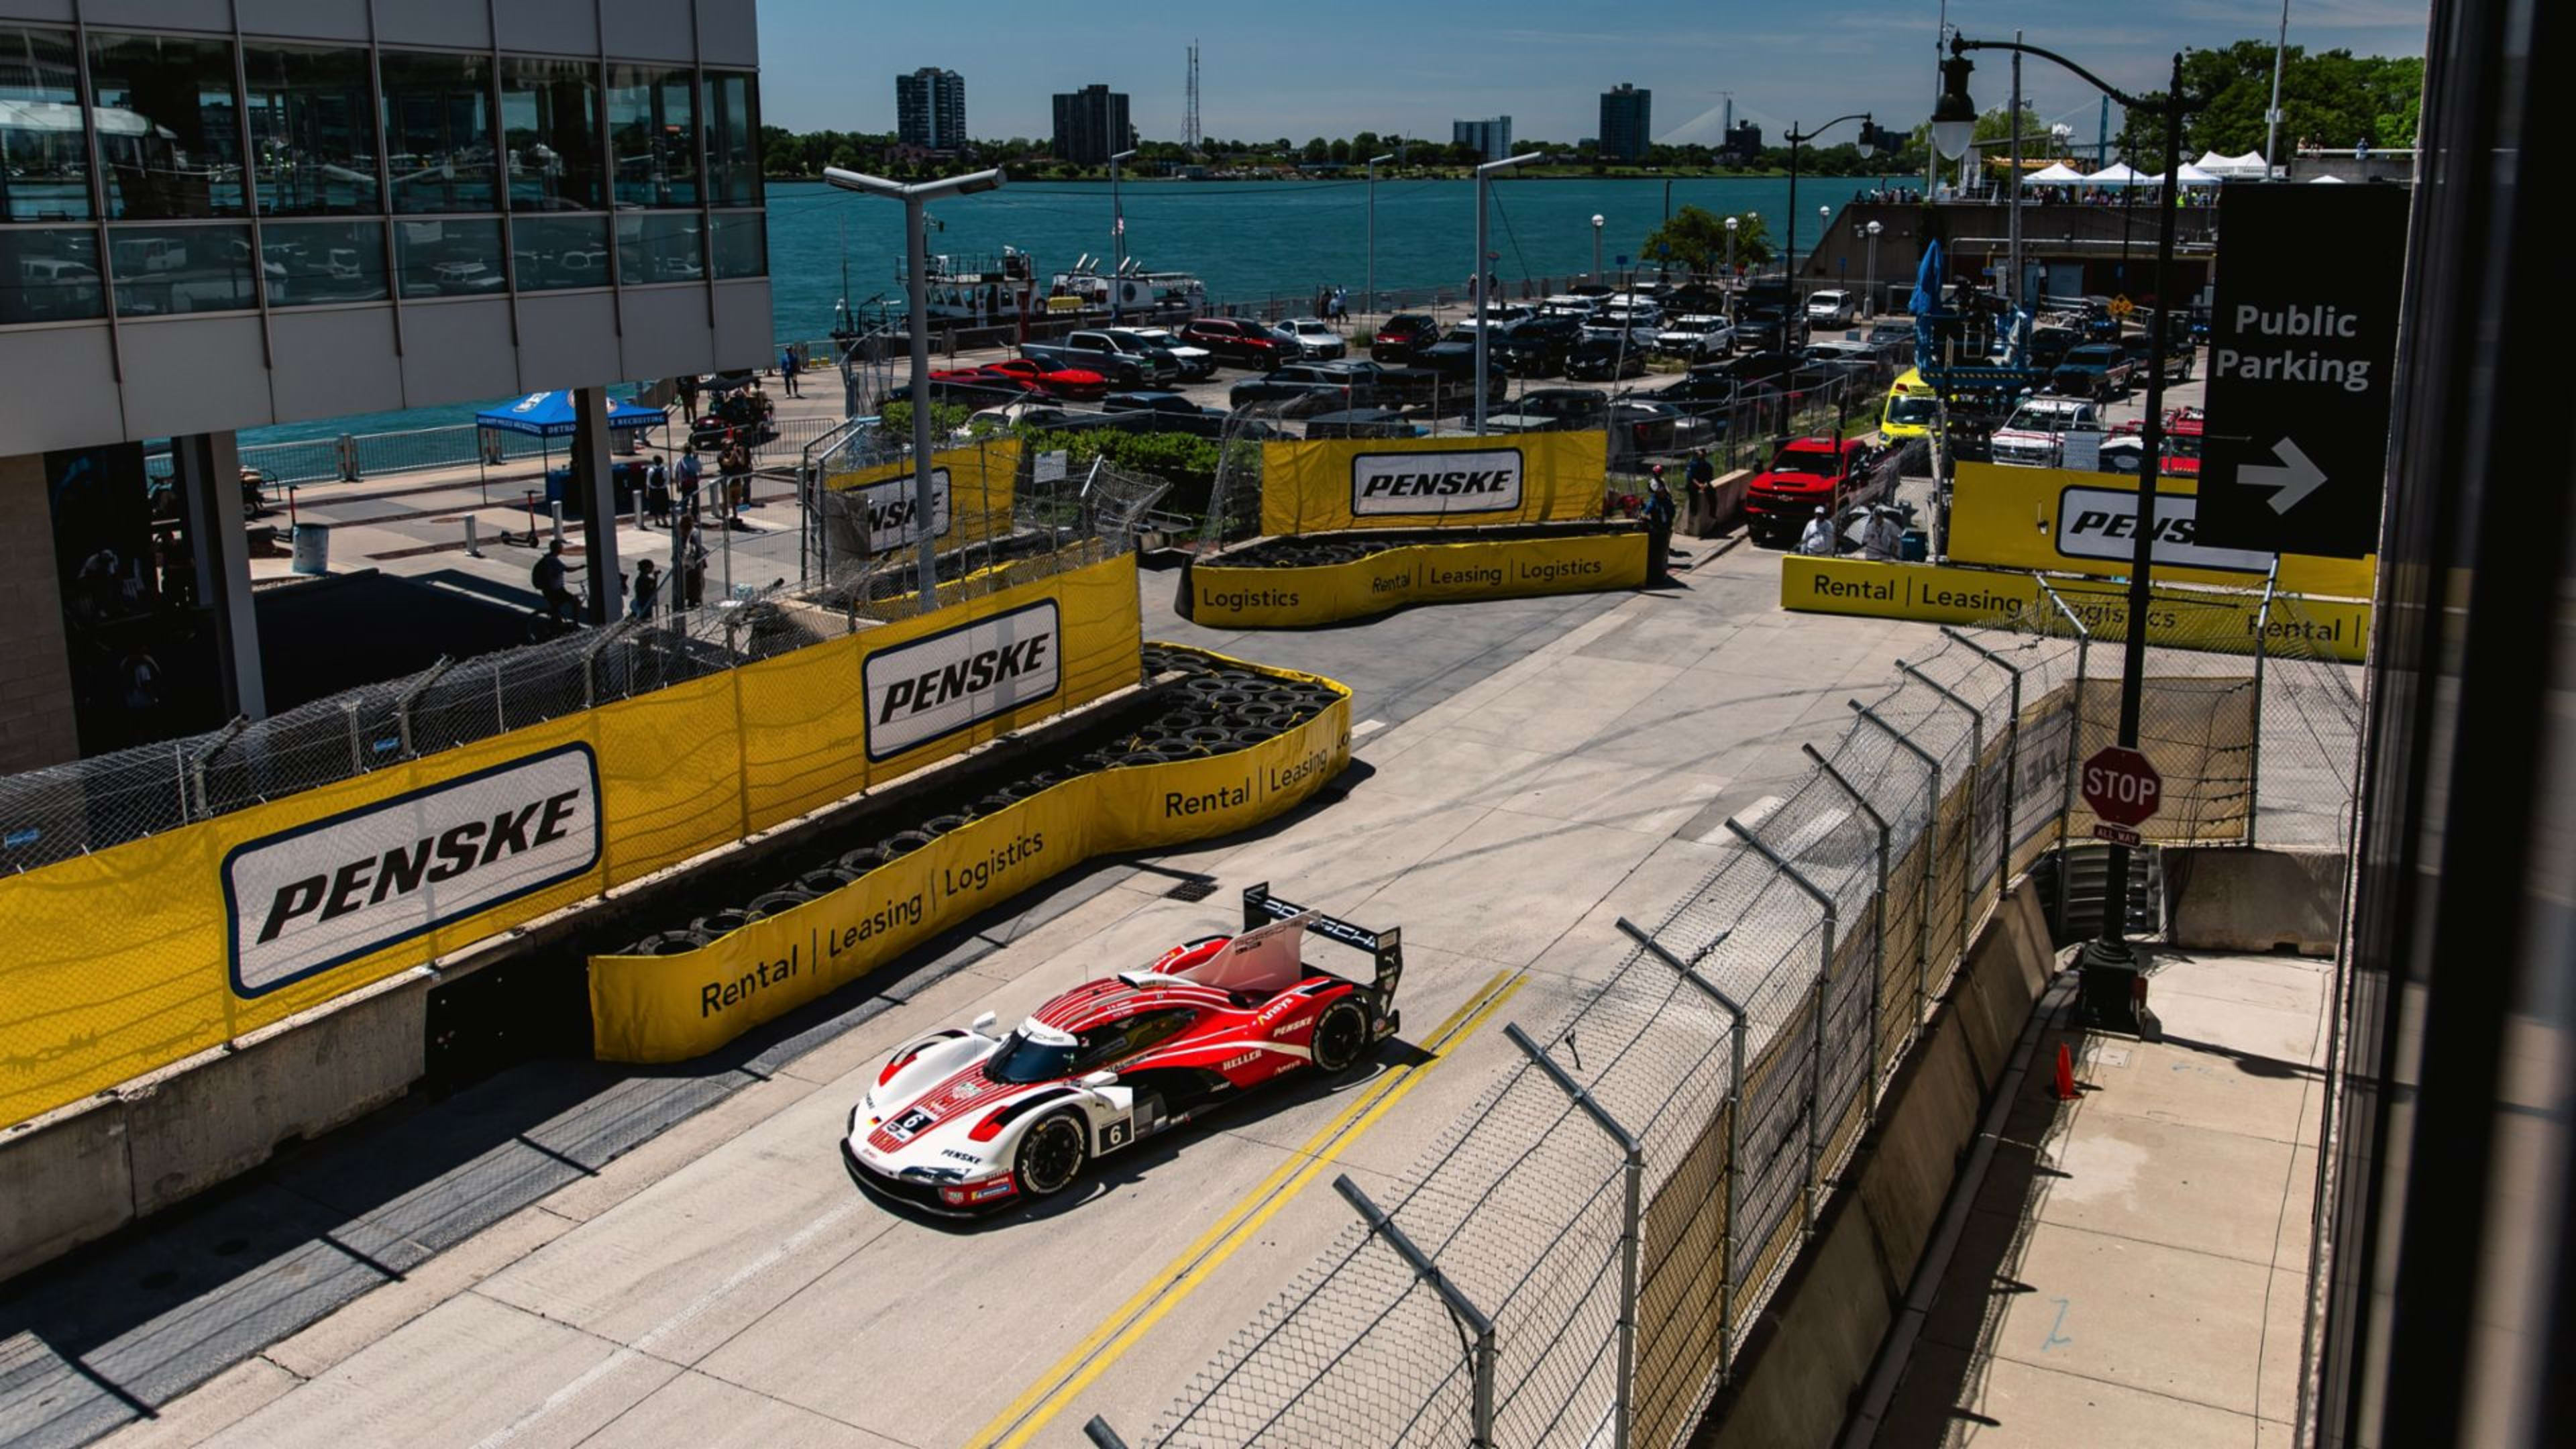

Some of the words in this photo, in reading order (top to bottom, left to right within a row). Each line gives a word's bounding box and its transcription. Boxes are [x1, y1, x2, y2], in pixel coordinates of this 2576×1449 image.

[2235, 305, 2357, 337] Public
[2216, 349, 2371, 392] Parking
[1363, 469, 1513, 498] PENSKE
[2070, 511, 2196, 545] PENS
[1372, 569, 1410, 594] Rental
[1431, 564, 1502, 588] Leasing
[1521, 557, 1603, 584] Logistics
[1203, 588, 1300, 613] Logistics
[1813, 574, 1894, 601] Rental
[1923, 583, 2023, 619] Leasing
[879, 632, 1051, 725] PENSKE
[1165, 776, 1250, 818] Rental
[1270, 747, 1328, 792] Leasing
[2086, 767, 2156, 806] STOP
[2097, 827, 2114, 839] ALL
[2118, 832, 2137, 844] WAY
[256, 788, 580, 945] PENSKE
[700, 944, 798, 1018] Rental
[828, 894, 923, 958] Leasing
[945, 832, 1044, 897] Logistics
[1257, 997, 1294, 1027] Ansys
[1273, 1016, 1313, 1038] PENSKE
[1223, 1049, 1263, 1071] HELLER
[904, 1114, 925, 1128] 6
[1110, 1124, 1122, 1144] 6
[941, 1148, 983, 1165] PENSKE
